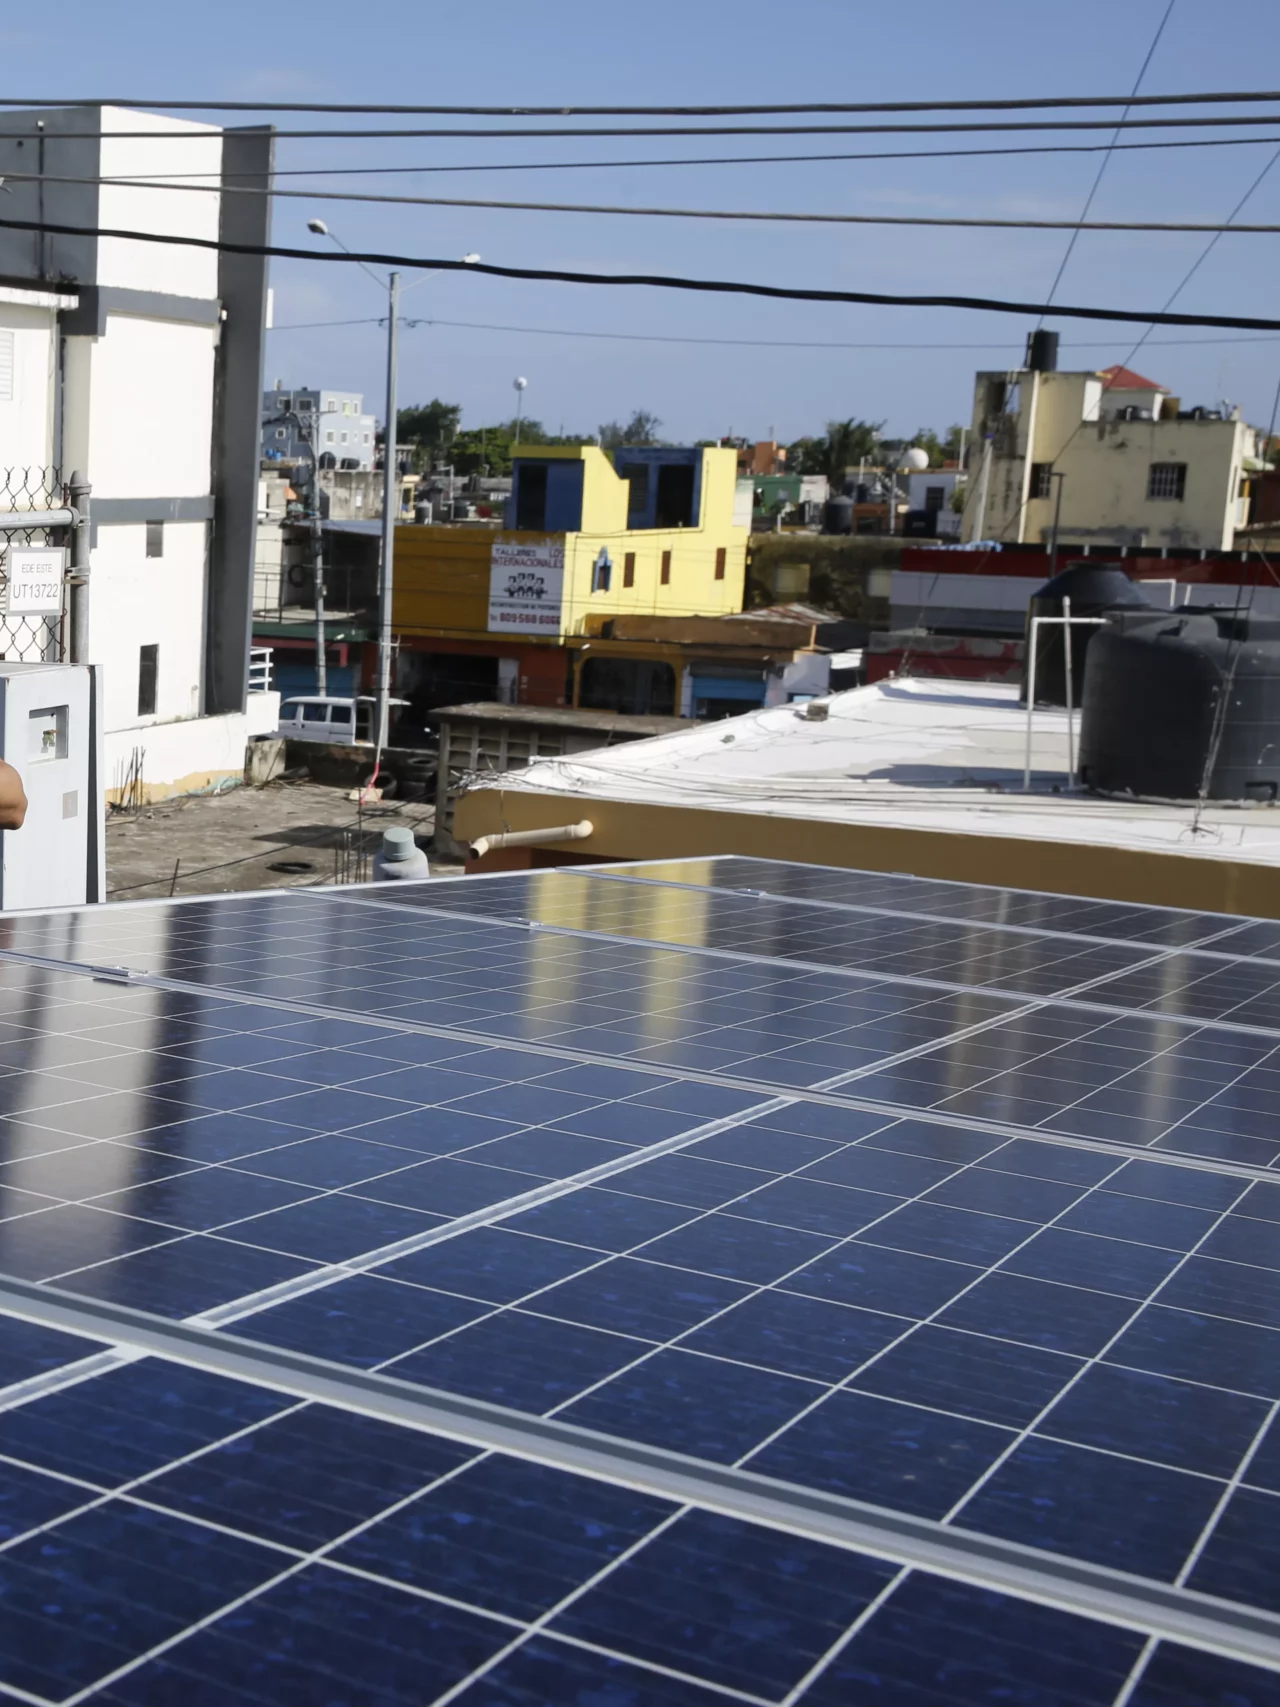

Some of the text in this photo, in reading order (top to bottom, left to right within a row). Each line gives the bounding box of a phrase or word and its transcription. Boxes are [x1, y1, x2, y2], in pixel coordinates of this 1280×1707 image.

[22, 564, 52, 573] EDE ESTE
[491, 557, 564, 569] INTERNACIONALES
[13, 584, 58, 599] UT13722
